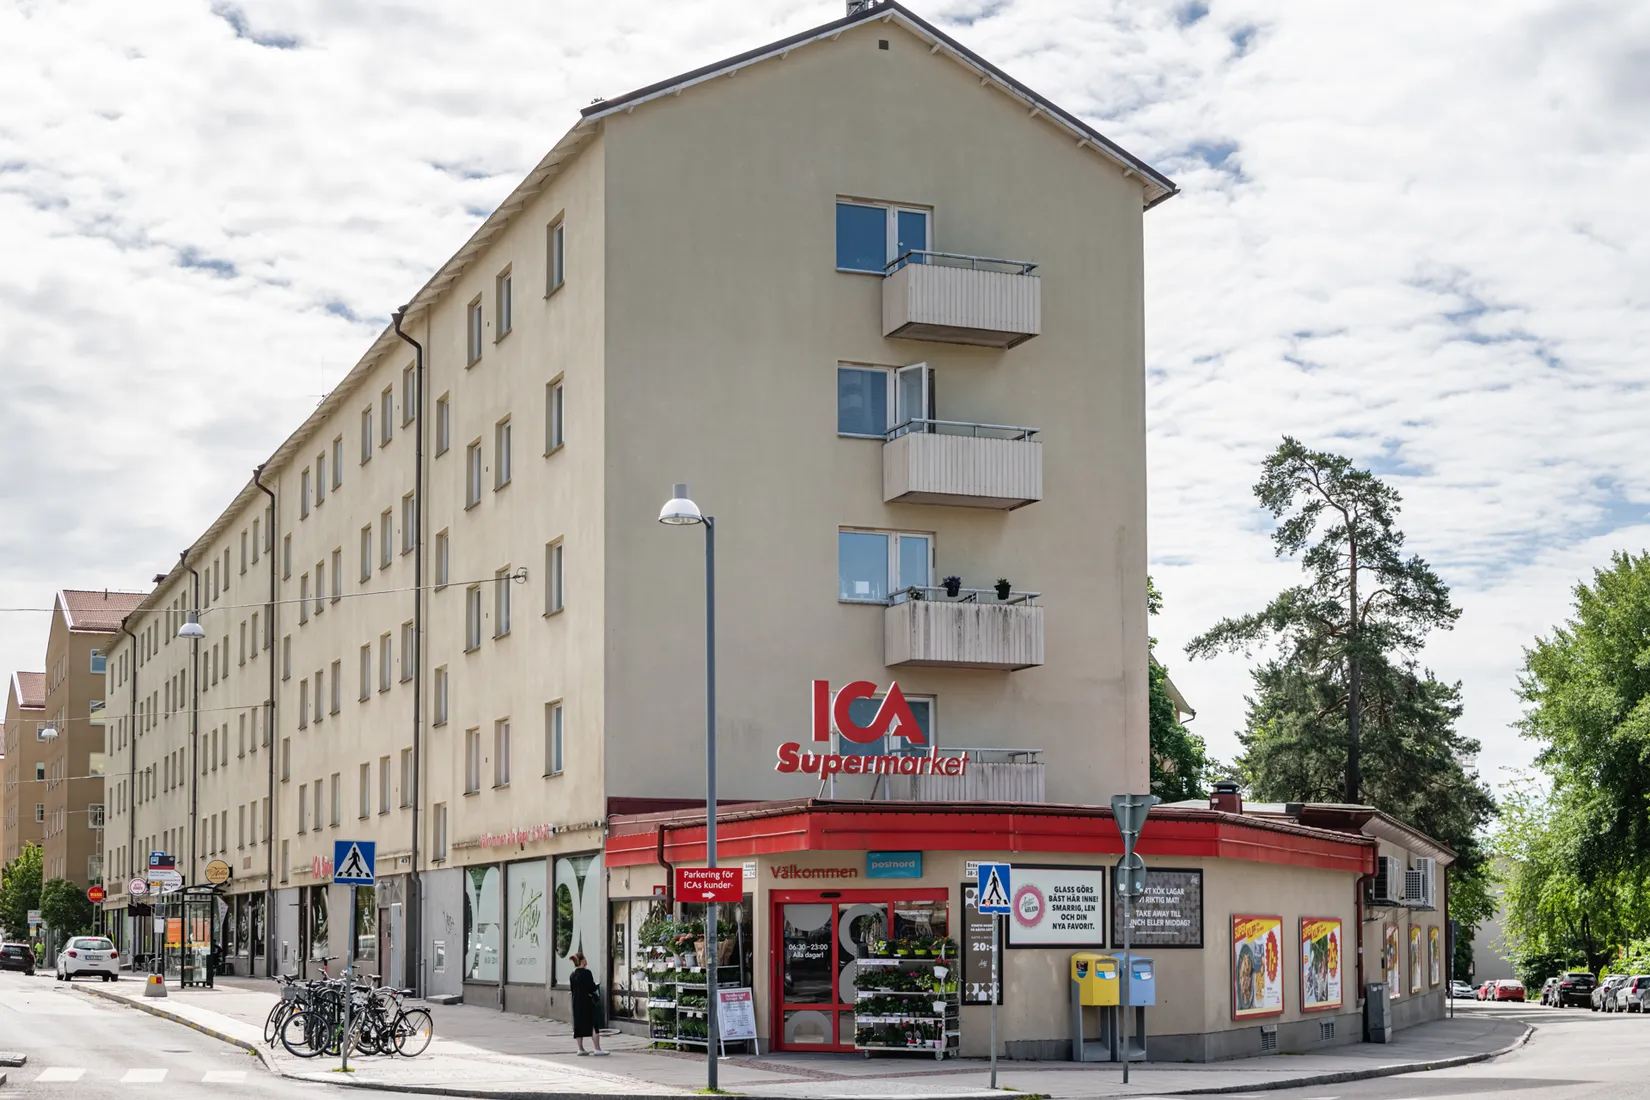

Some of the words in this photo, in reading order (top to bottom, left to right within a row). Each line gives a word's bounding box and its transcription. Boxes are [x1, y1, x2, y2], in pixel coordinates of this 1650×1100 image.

[812, 680, 927, 744] ICA
[774, 741, 970, 780] Supermarket
[871, 860, 915, 870] postnord
[684, 870, 720, 880] Parkering
[722, 870, 734, 878] för
[770, 864, 858, 880] Välkommen
[684, 881, 702, 889] ICAs
[1076, 885, 1094, 893] GÖRS
[1153, 886, 1165, 895] KÖK
[1048, 894, 1065, 902] BÄST
[1066, 894, 1080, 902] HÄR
[1165, 919, 1191, 927] MIDDAG?
